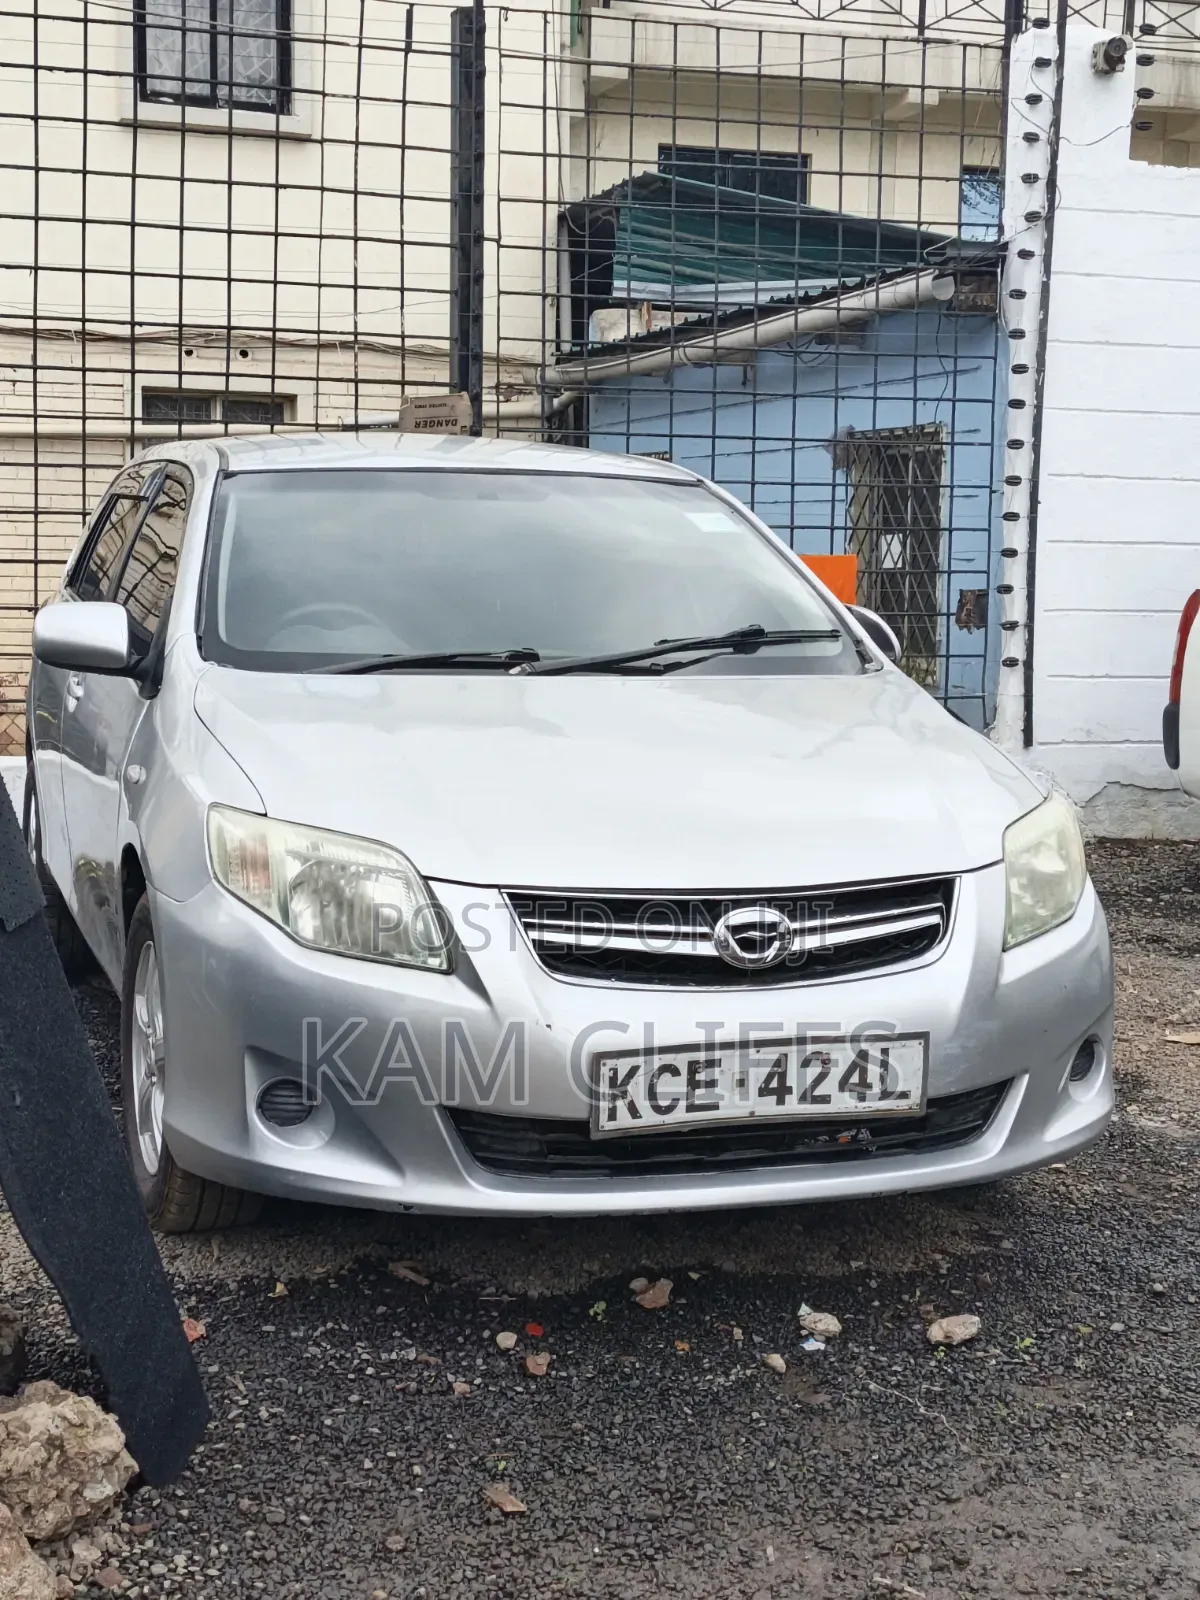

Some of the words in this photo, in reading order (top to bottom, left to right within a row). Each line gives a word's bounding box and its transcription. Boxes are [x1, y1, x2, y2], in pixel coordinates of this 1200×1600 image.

[414, 418, 458, 429] DANGER
[607, 1058, 722, 1122] KCE
[757, 1047, 912, 1107] 424L
